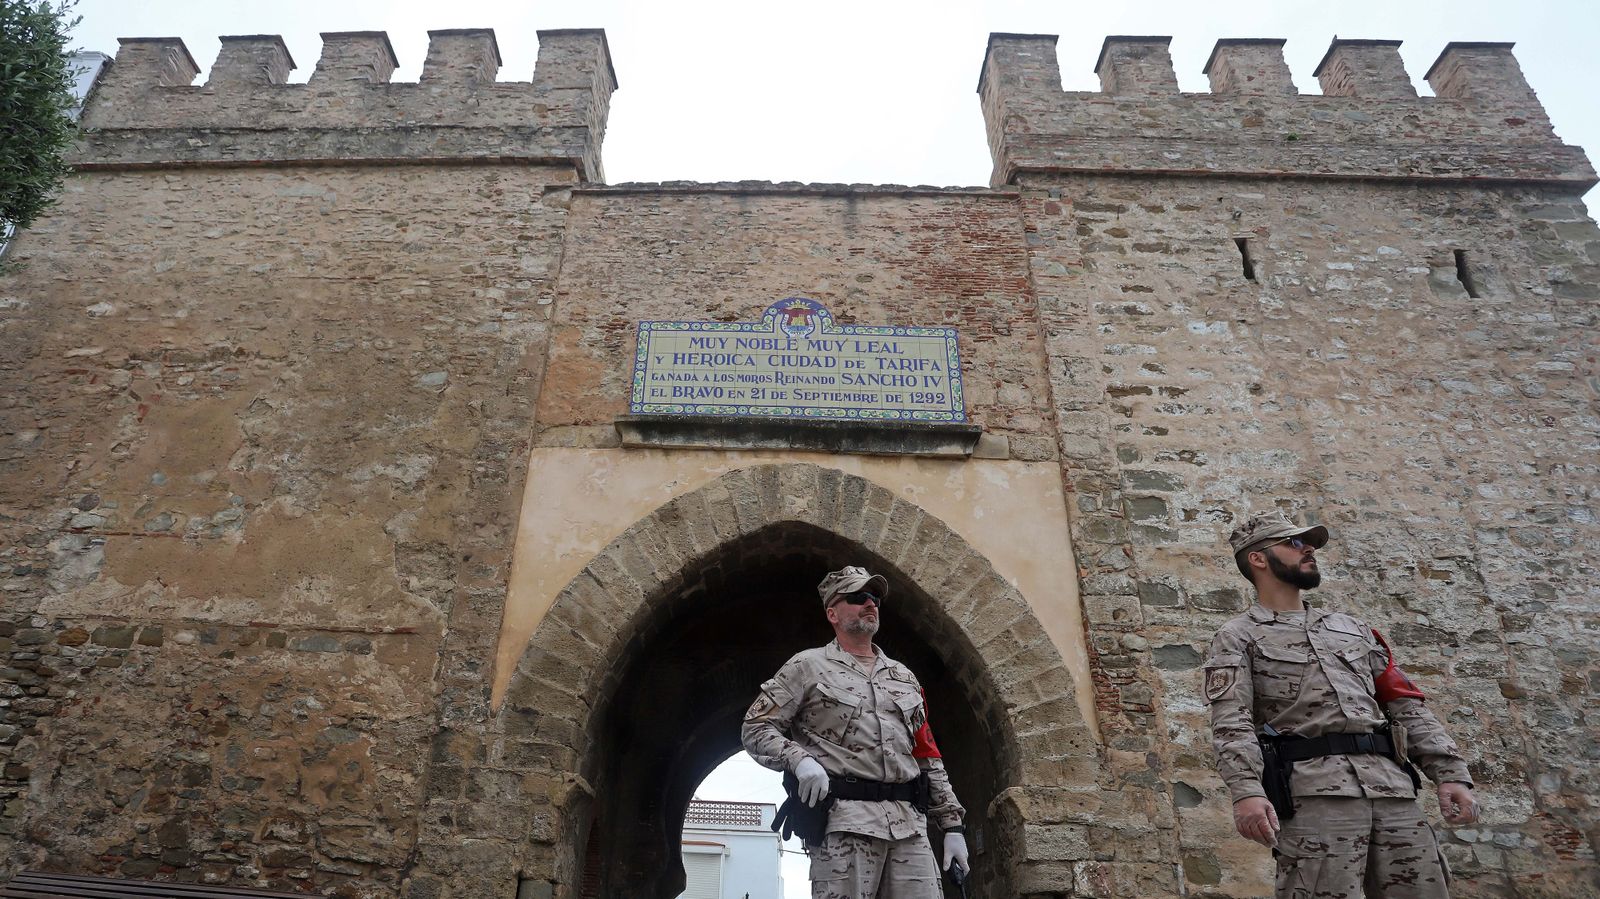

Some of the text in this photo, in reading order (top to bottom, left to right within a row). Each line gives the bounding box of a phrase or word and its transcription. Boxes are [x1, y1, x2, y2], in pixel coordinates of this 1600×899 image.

[688, 337, 904, 355] MUY NOBLE MUY LEAL
[656, 353, 941, 372] Y HEROICA CIUDAD DE TARIFA
[651, 373, 698, 382] GANADA
[703, 373, 710, 381] A
[714, 373, 734, 382] LOS
[736, 374, 772, 383] MOROS
[841, 373, 918, 387] SANCHO
[924, 376, 942, 388] IV
[651, 388, 667, 397] EL
[672, 387, 723, 399] BRAVO
[728, 390, 745, 398] EN
[750, 388, 765, 399] 21
[771, 391, 787, 400] DE
[886, 394, 903, 403] DE
[910, 392, 945, 404] 1292
